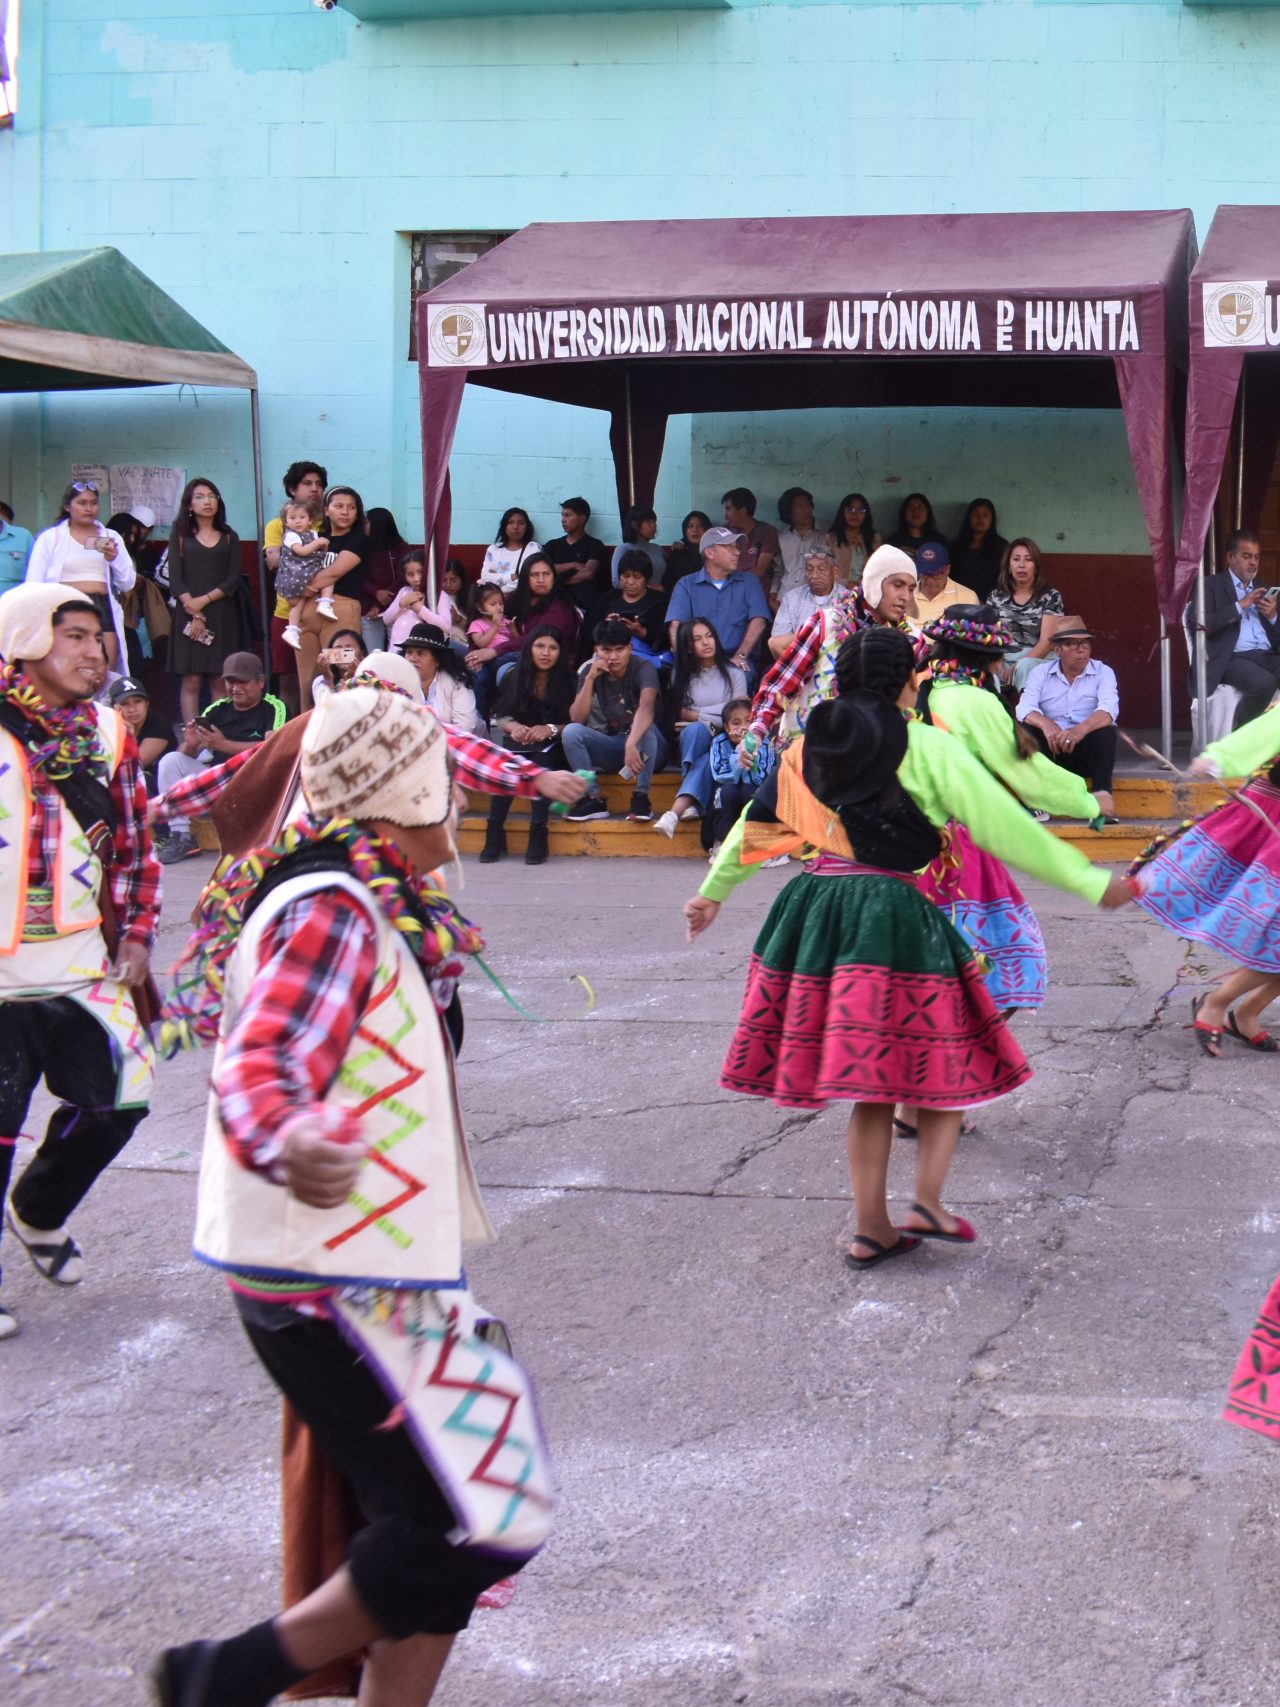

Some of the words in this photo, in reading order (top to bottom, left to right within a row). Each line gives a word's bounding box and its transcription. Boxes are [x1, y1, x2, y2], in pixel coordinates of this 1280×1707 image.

[489, 305, 667, 363] UNIVERSIDAD
[675, 301, 812, 353] NACIONAL
[823, 291, 981, 351] AUTÓNOMA
[996, 300, 1015, 352] DE
[1025, 300, 1140, 352] HUANTA
